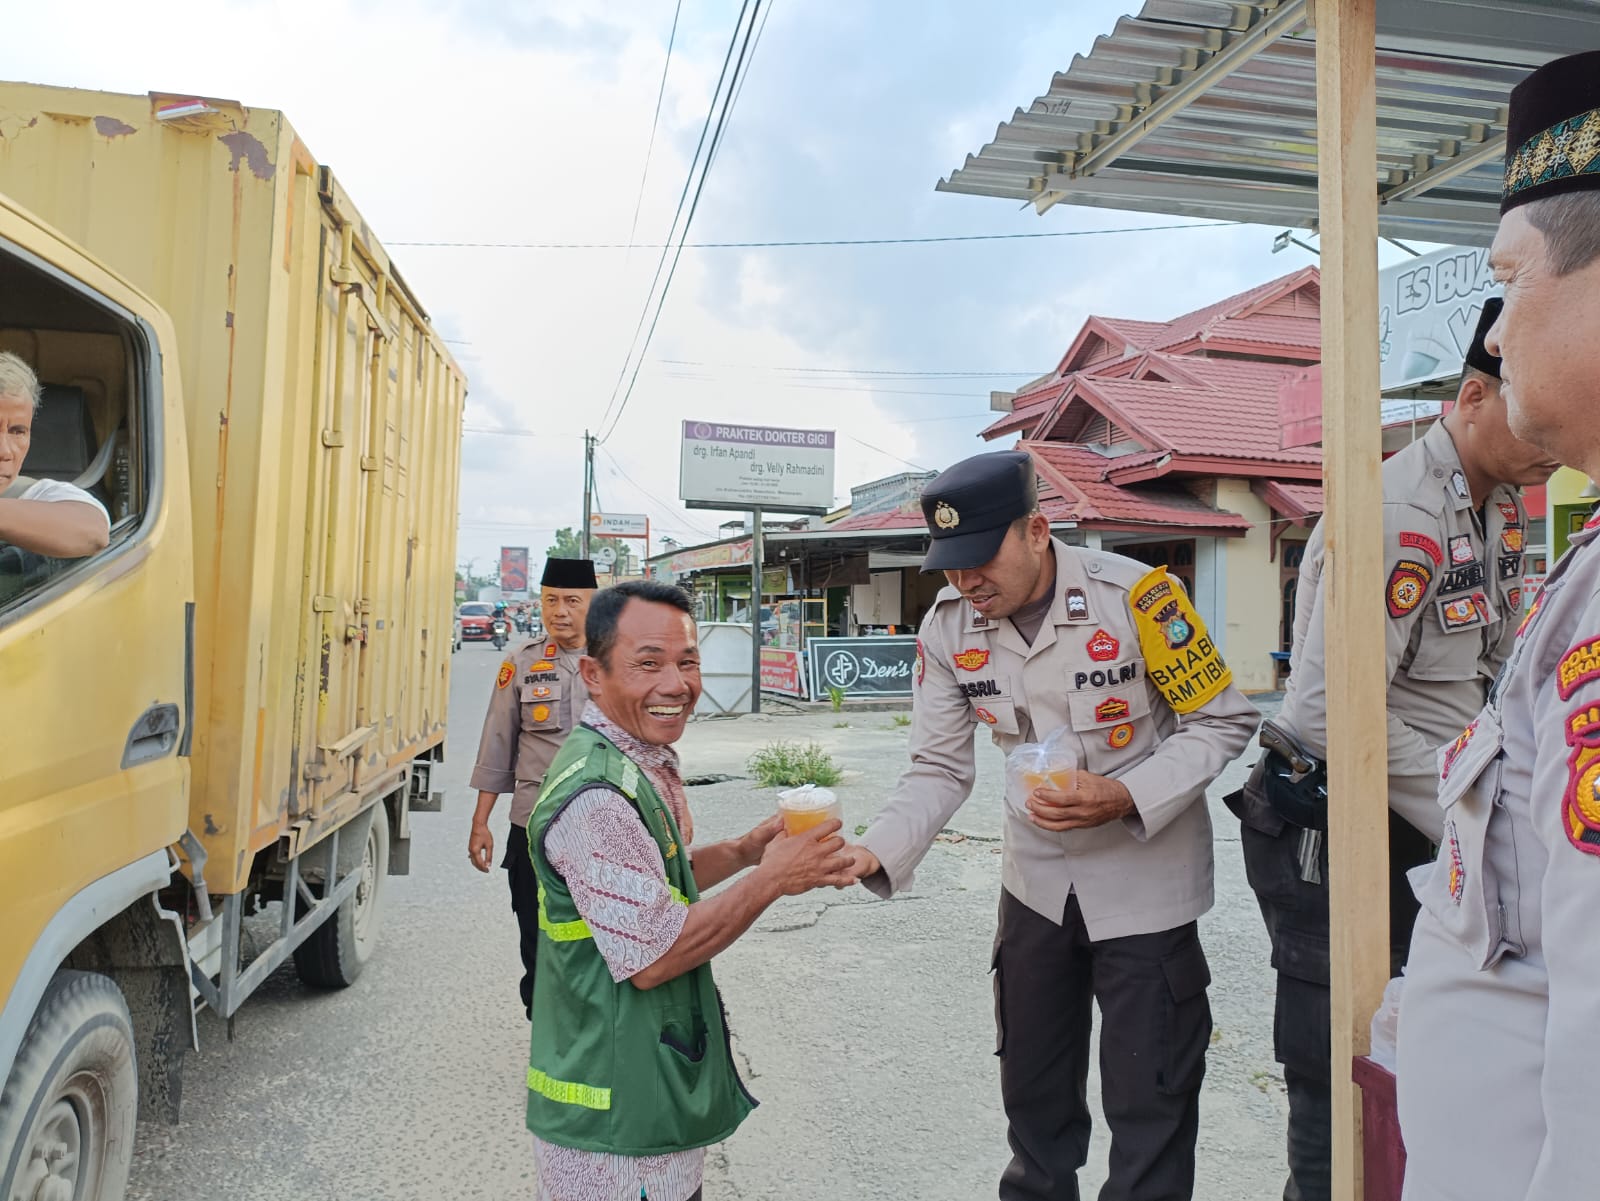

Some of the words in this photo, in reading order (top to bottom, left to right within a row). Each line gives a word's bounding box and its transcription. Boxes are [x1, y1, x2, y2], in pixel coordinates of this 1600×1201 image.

[1396, 267, 1431, 315] ES
[715, 426, 762, 441] PRAKTEK
[764, 430, 805, 444] DOKTER
[807, 434, 828, 445] GIGI
[693, 444, 708, 459] drg.
[710, 446, 728, 458] Irfan
[729, 447, 756, 460] Apandi
[750, 462, 765, 474] drg.
[786, 463, 825, 476] Rahmadini
[860, 657, 910, 678] Den's
[1075, 662, 1136, 690] POLRI
[1167, 656, 1226, 706] AMTIB
